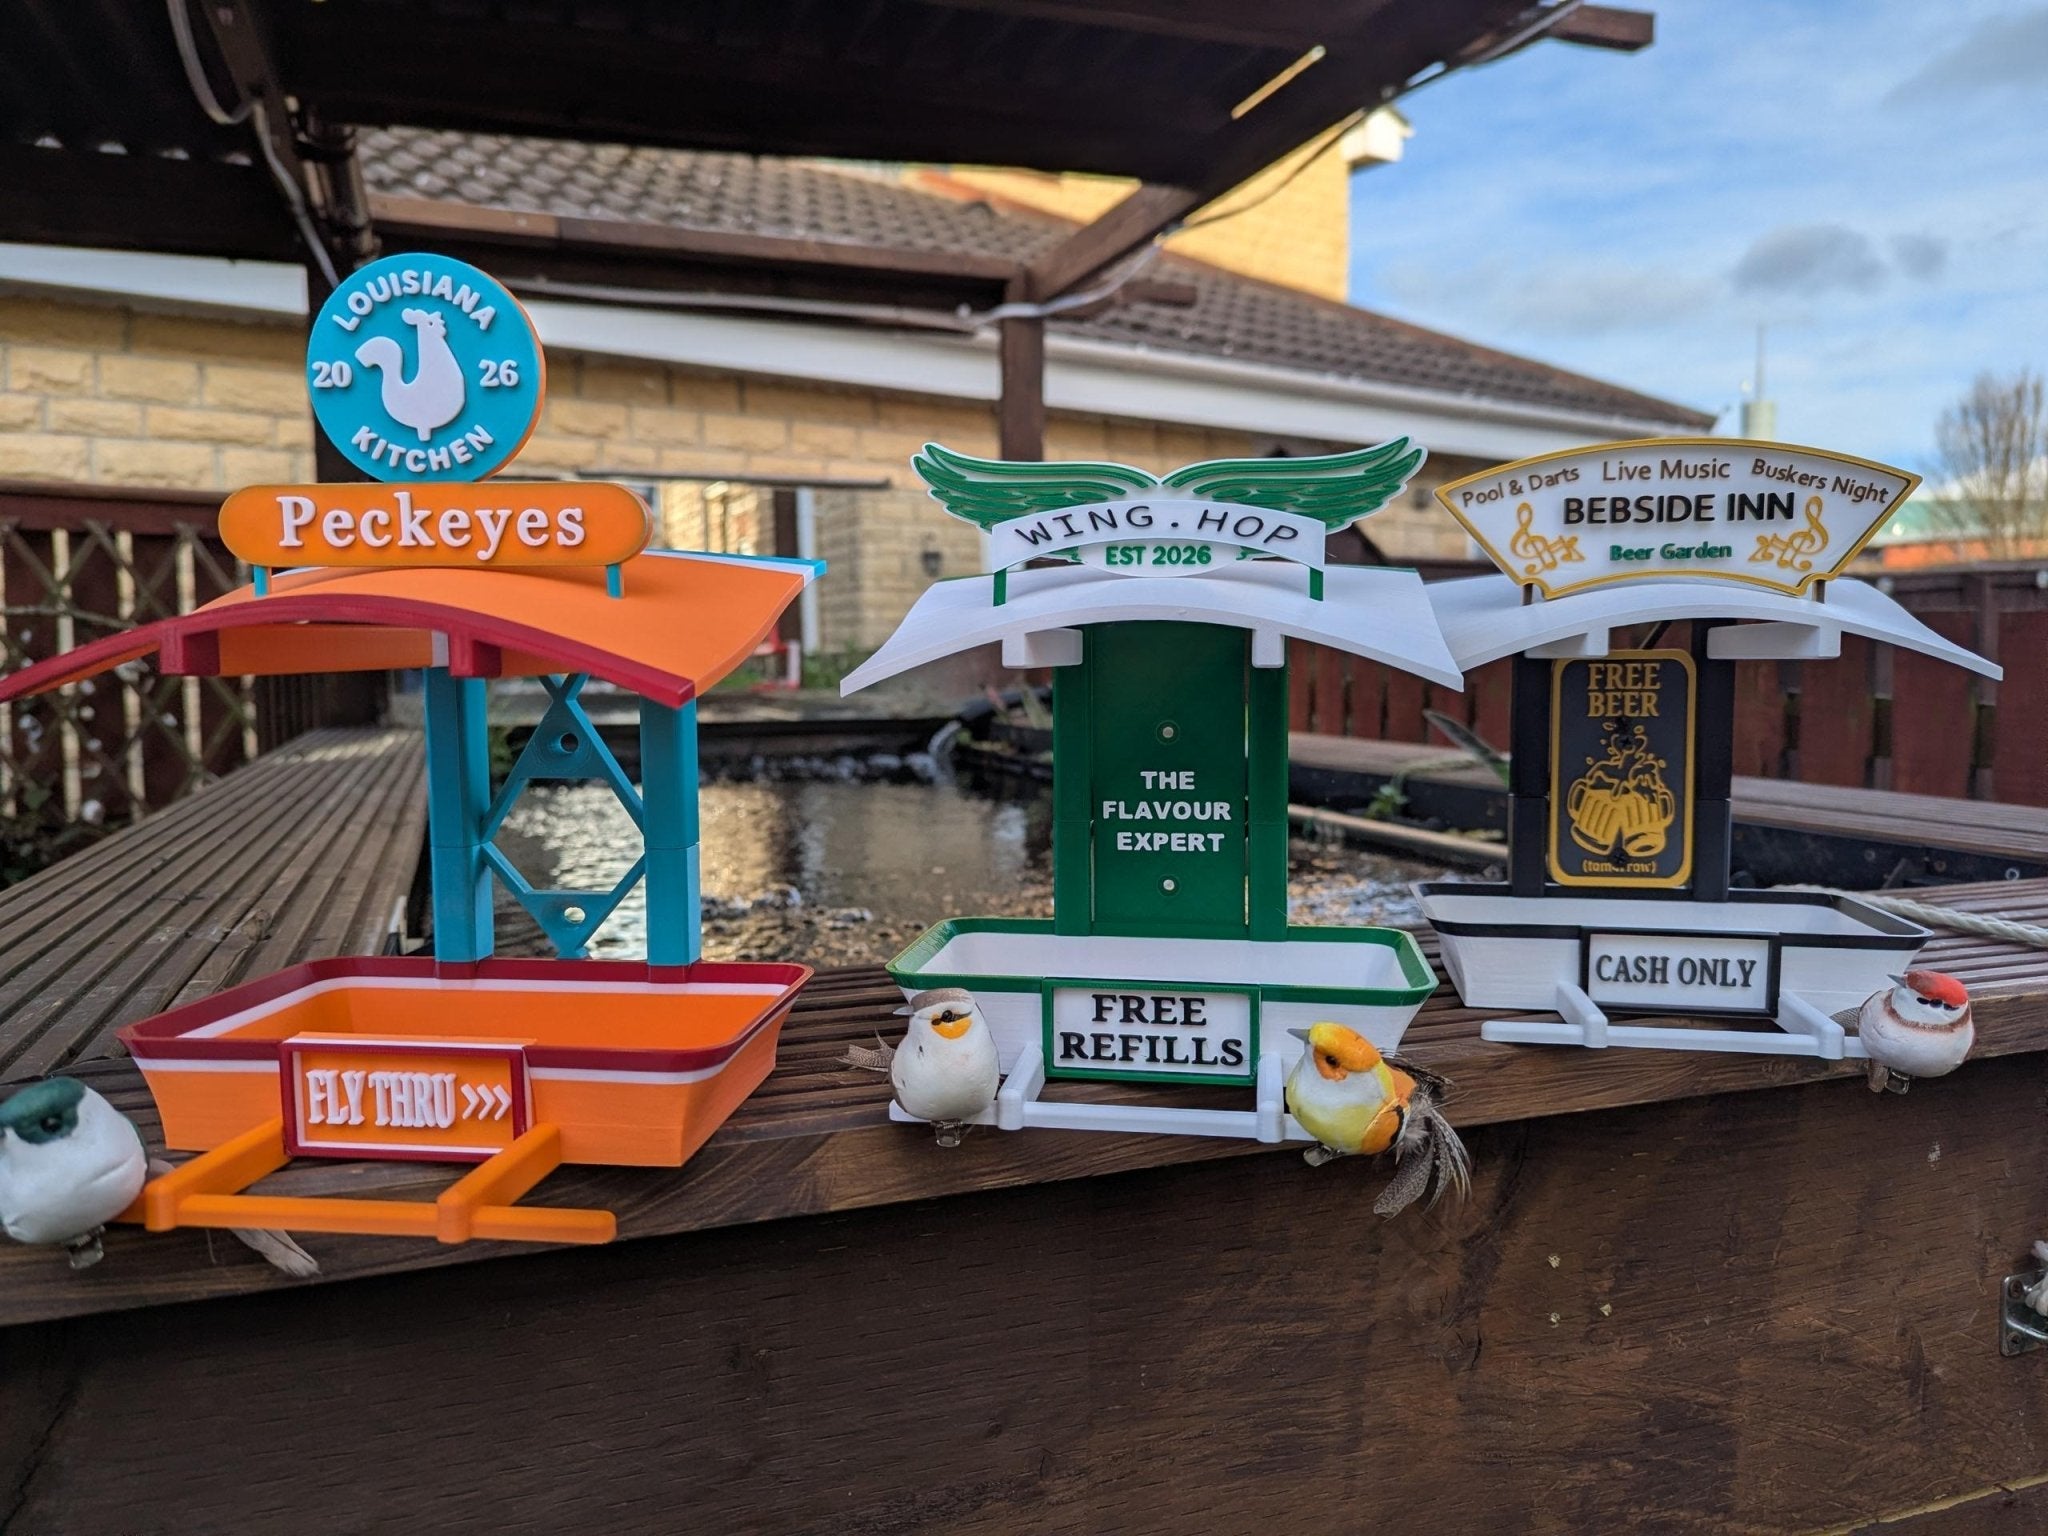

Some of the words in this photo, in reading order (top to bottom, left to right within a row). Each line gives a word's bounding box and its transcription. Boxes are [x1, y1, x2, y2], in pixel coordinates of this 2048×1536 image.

[333, 269, 496, 332] LOUISIANA
[312, 361, 352, 388] 20
[479, 360, 520, 388] 26
[351, 424, 494, 473] KITCHEN
[1603, 461, 1651, 481] Live
[1660, 458, 1731, 479] Music
[1752, 458, 1827, 489] Buskers
[1832, 476, 1889, 503] Night
[1462, 483, 1504, 507] Pool
[1509, 479, 1524, 495] &
[1528, 467, 1580, 491] Darts
[1564, 494, 1715, 525] BEBSIDE
[1727, 492, 1795, 521] INN
[276, 492, 586, 560] Peckeyes
[1106, 546, 1146, 565] EST
[1152, 545, 1212, 565] 2026
[1609, 544, 1655, 562] Beer
[1660, 541, 1732, 560] Garden
[1587, 663, 1662, 690] FREE
[1587, 692, 1659, 717] BEER
[1140, 771, 1195, 790] THE
[1103, 801, 1231, 821] FLAVOUR
[1117, 832, 1225, 852] EXPERT
[1595, 955, 1670, 984] CASH
[1678, 957, 1757, 987] ONLY
[1092, 993, 1207, 1026] FREE
[1059, 1032, 1244, 1066] REFILLS
[306, 1069, 367, 1125] FLY
[368, 1071, 457, 1129] THRU
